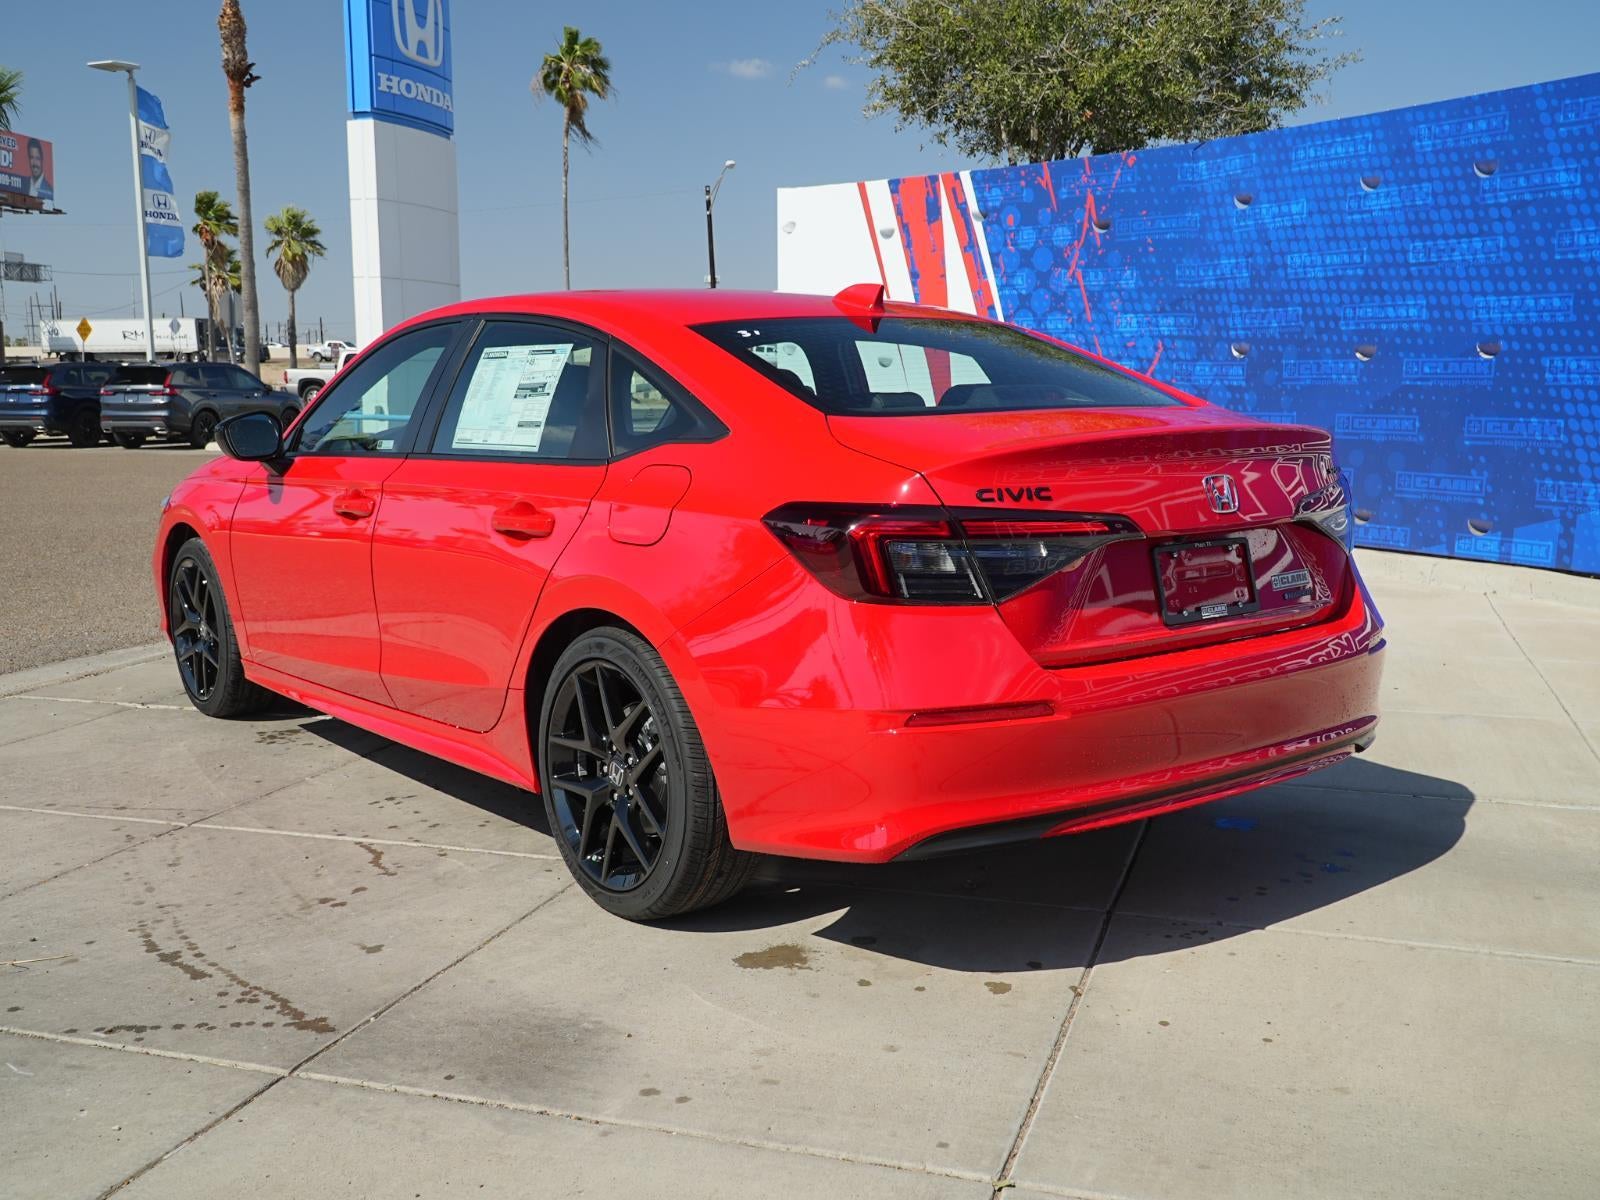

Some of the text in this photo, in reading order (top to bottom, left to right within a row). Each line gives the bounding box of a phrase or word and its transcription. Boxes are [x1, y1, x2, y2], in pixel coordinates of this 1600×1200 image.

[378, 72, 453, 112] HONDA
[1423, 361, 1490, 376] CLARK
[1486, 421, 1560, 438] CLARK
[976, 486, 1053, 503] CIVIC
[1280, 572, 1308, 585] CLARK
[1206, 605, 1227, 614] CLARK
